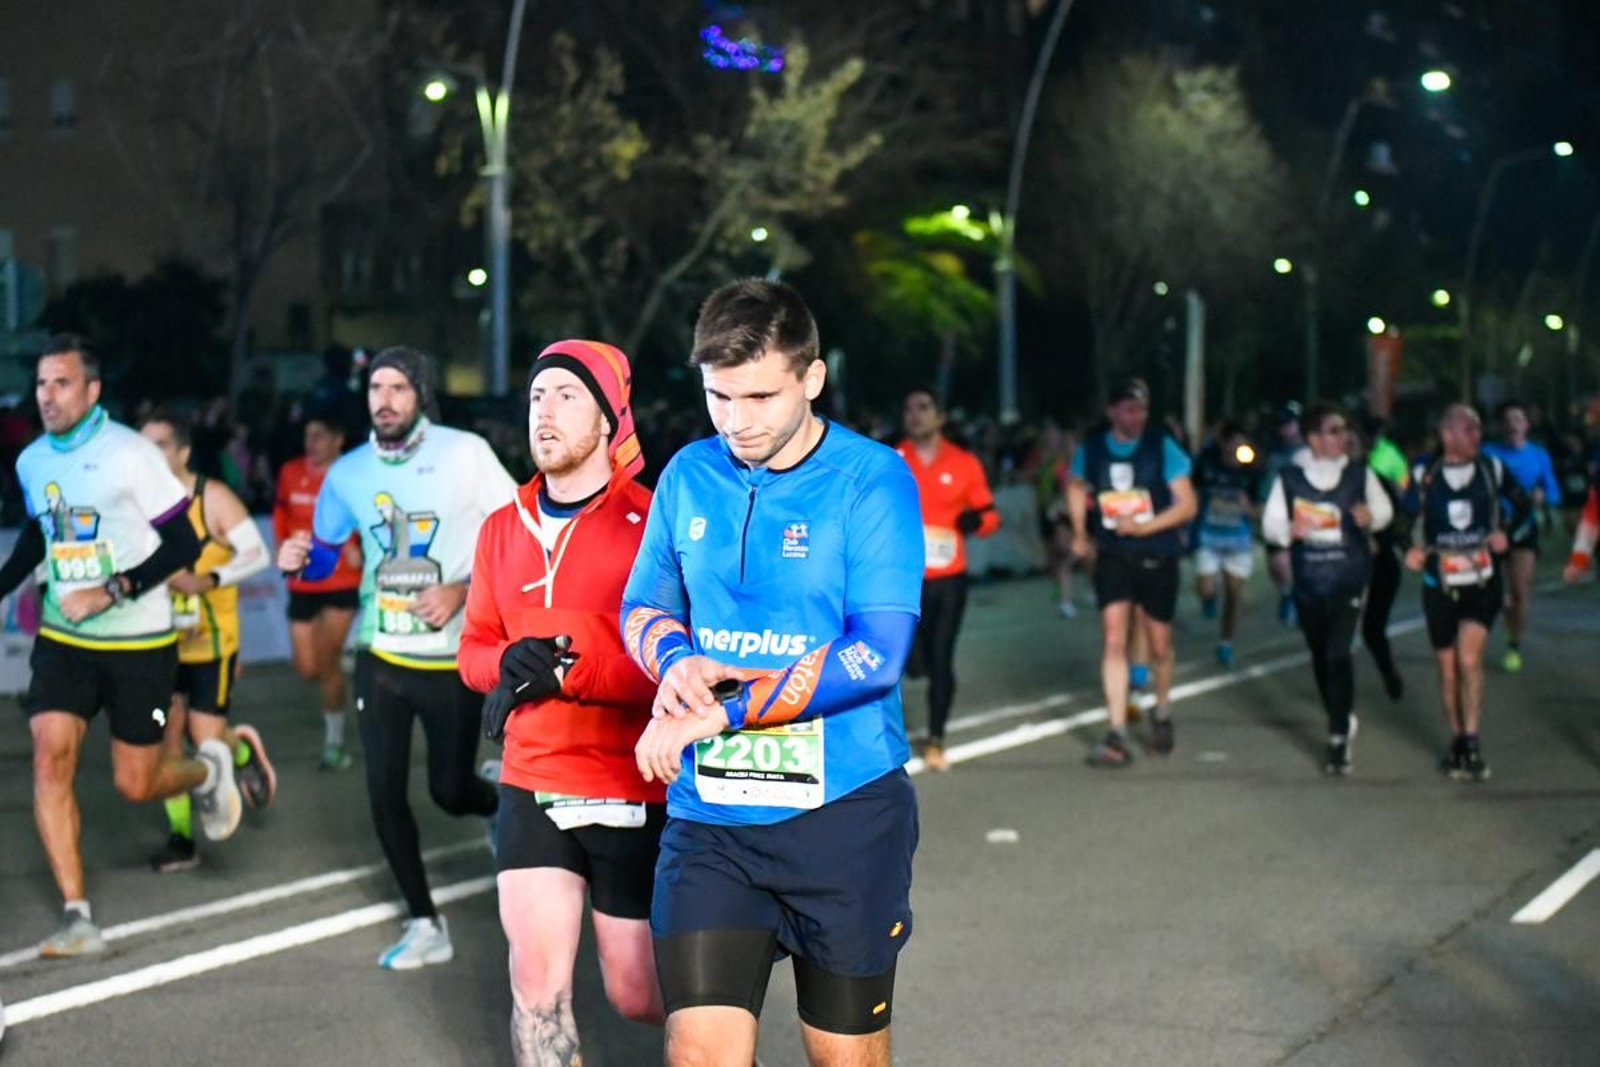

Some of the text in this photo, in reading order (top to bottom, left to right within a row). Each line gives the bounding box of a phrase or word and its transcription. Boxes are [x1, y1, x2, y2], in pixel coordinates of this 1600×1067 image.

[57, 558, 102, 581] 995
[697, 627, 807, 659] nerplus
[701, 733, 809, 772] 2203
